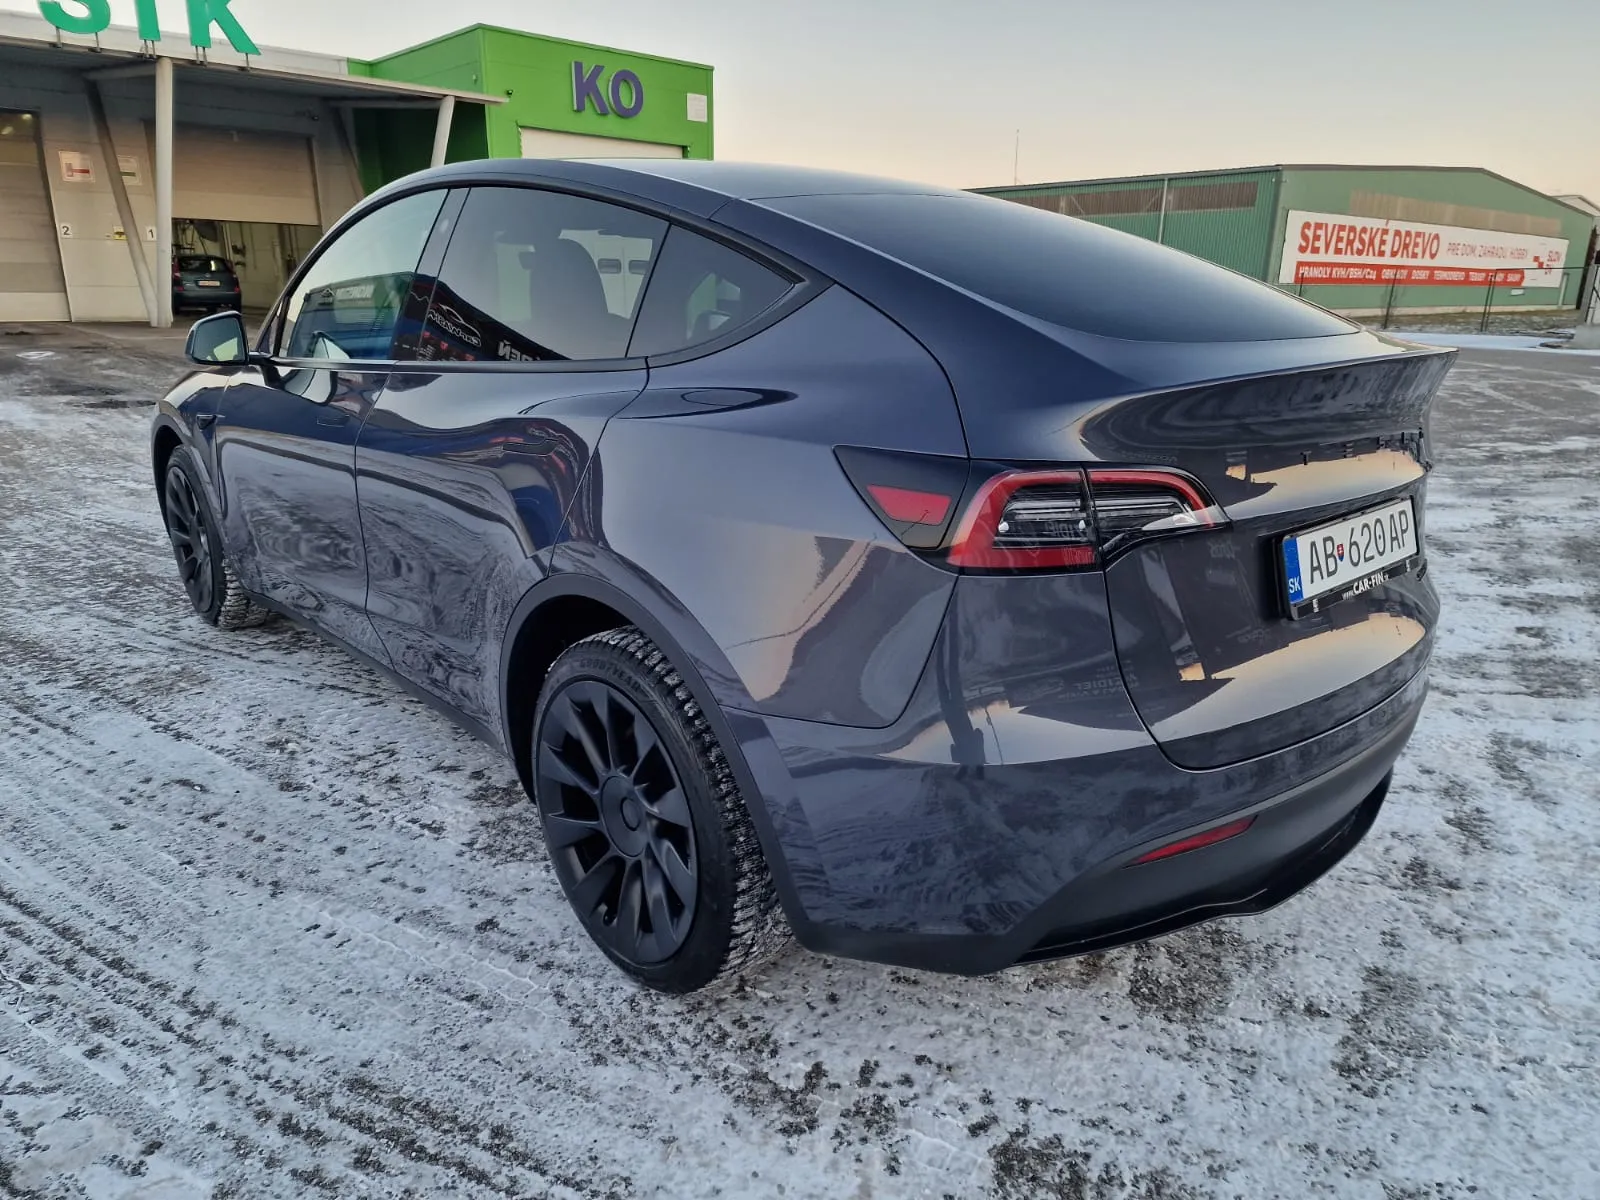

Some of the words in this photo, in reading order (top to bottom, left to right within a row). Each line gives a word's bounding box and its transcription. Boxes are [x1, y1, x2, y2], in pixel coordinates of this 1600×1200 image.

[571, 60, 644, 119] KO
[61, 225, 70, 236] 2
[1297, 219, 1390, 258] SEVERSKÉ
[1390, 228, 1441, 260] DREVO
[1309, 535, 1339, 585] AB
[1348, 517, 1386, 567] 620
[1390, 509, 1410, 553] AP
[1287, 575, 1302, 594] SK
